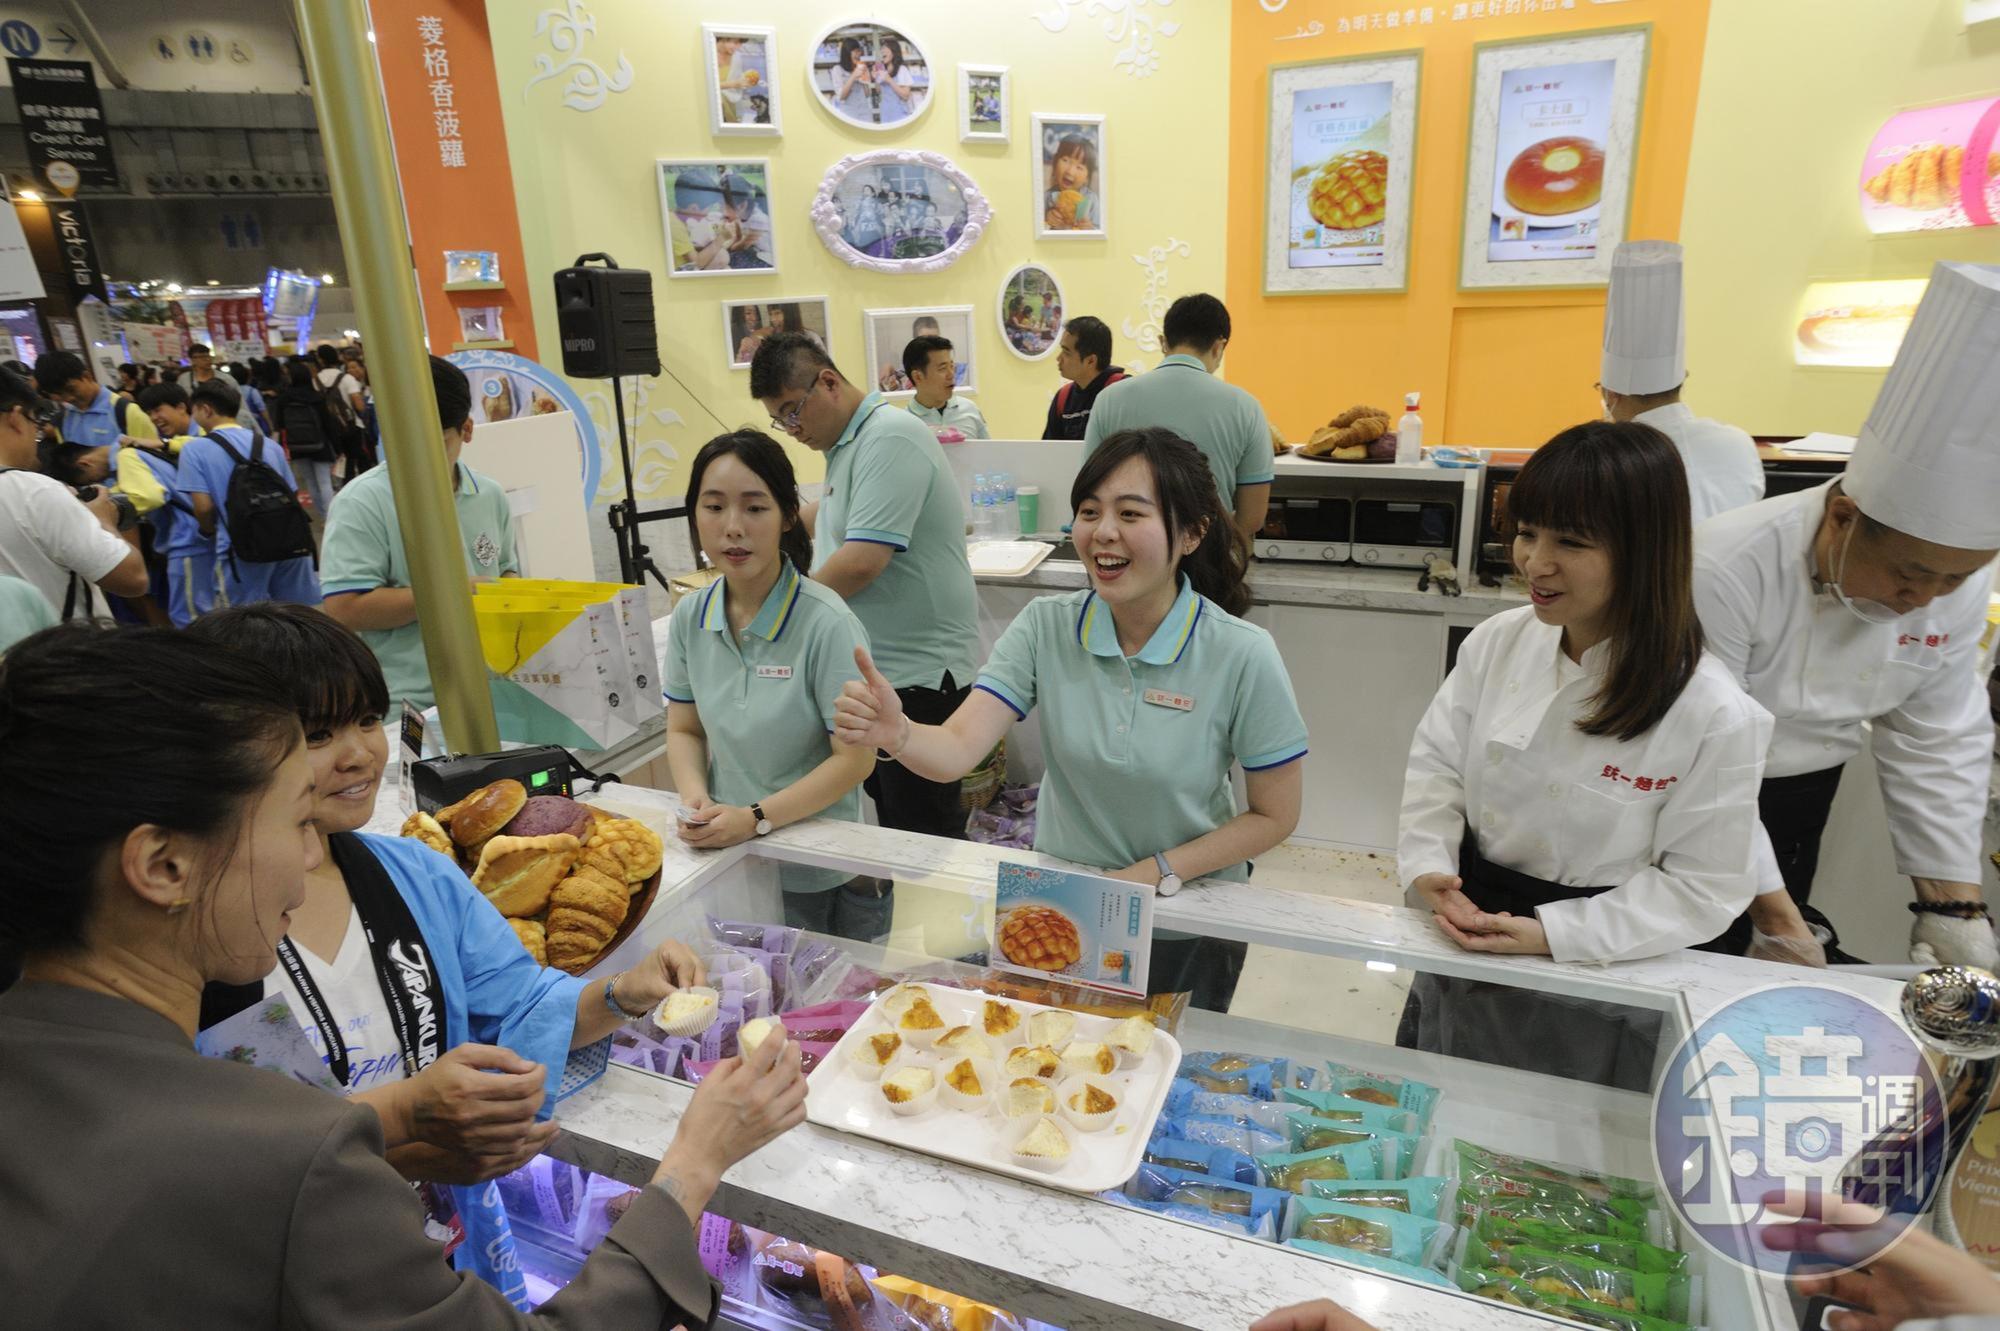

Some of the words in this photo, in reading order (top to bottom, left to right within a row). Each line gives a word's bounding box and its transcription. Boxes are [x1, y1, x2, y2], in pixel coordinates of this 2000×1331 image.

[6, 26, 34, 52] N
[416, 15, 467, 168] 菱格香菠蘿
[30, 132, 72, 145] Credit
[73, 133, 105, 146] Card
[46, 147, 97, 160] Service
[294, 970, 313, 997] TAIWAN
[308, 994, 326, 1022] VISITORS
[321, 1020, 341, 1062] ASSOCIATION
